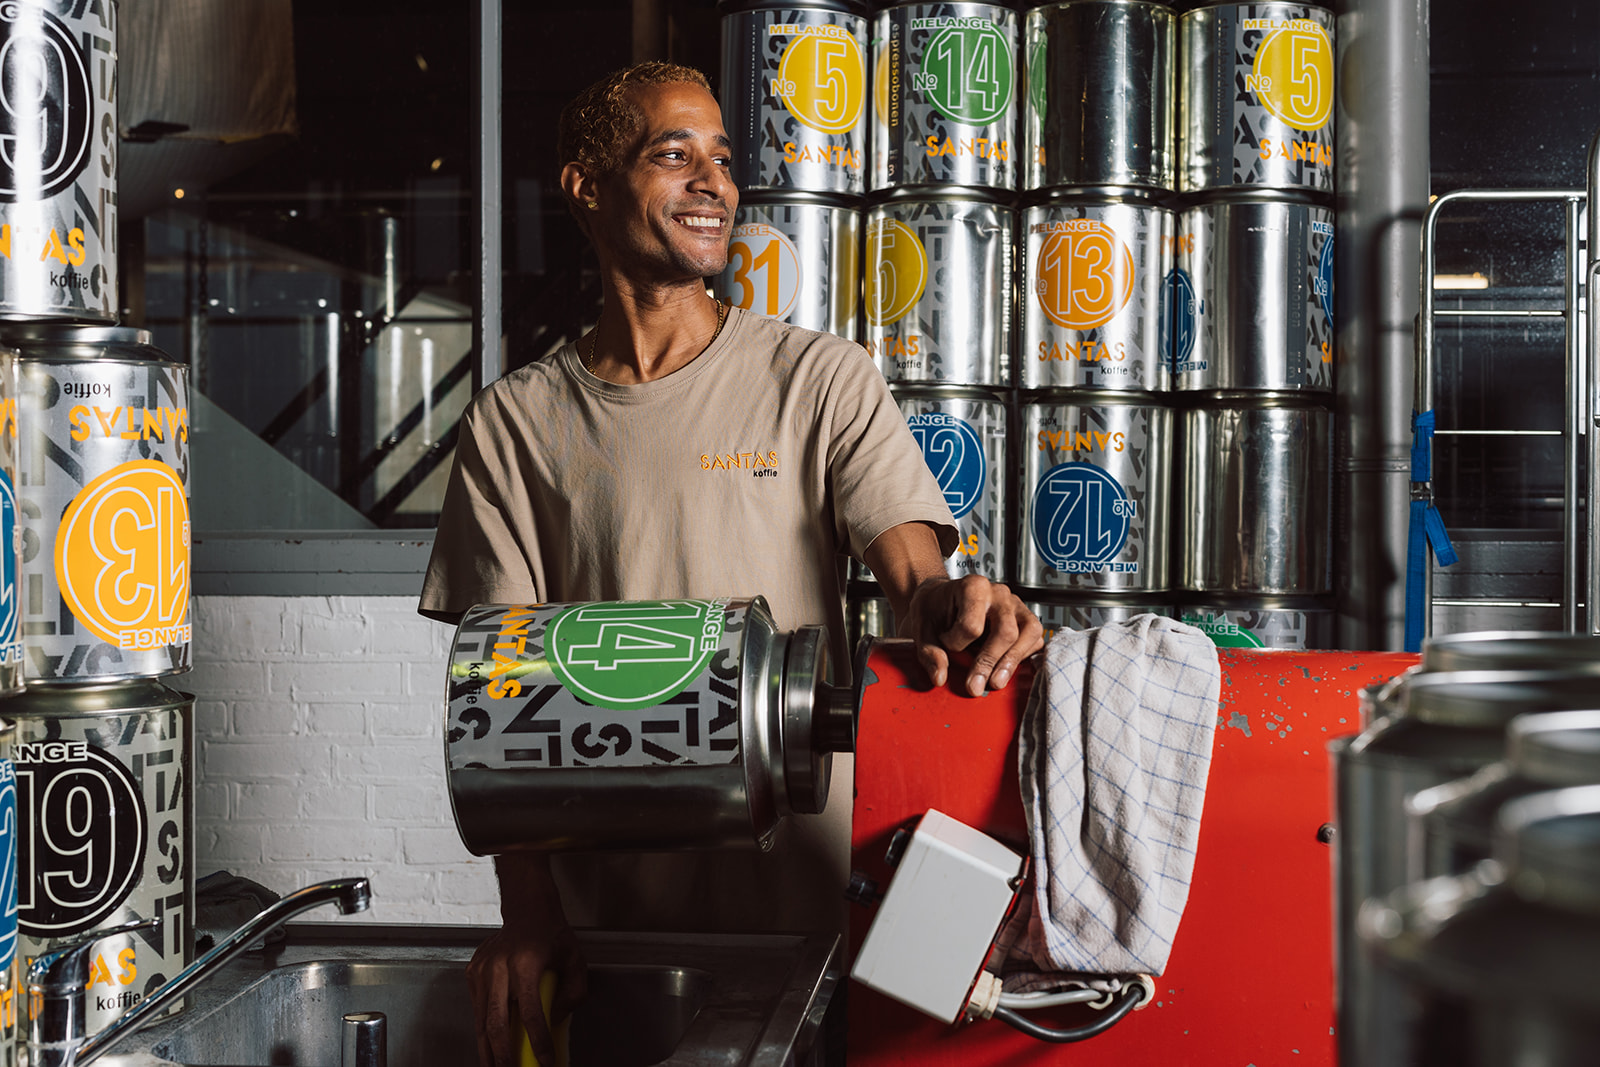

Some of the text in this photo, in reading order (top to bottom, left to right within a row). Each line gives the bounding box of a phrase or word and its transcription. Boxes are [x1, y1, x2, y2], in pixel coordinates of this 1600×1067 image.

[768, 24, 848, 39] MELANGE
[912, 17, 992, 31] MELANGE
[1243, 18, 1320, 32] MELANGE
[814, 39, 848, 124] 5
[891, 23, 900, 127] espressobonen
[938, 31, 999, 112] 14
[1290, 35, 1321, 119] 5
[784, 142, 861, 169] SANTAS
[926, 136, 1008, 161] SANTAS
[1259, 138, 1332, 166] SANTAS
[1030, 220, 1101, 234] MELANGE
[50, 271, 89, 290] koffie
[725, 240, 780, 315] 31
[1045, 234, 1116, 315] 13
[1038, 341, 1125, 362] SANTAS
[1101, 365, 1128, 375] koffie
[64, 382, 111, 398] koffie
[69, 404, 188, 442] SANTAS
[1038, 430, 1125, 452] SANTAS
[700, 451, 778, 470] SANTAS
[753, 468, 778, 478] koffie
[1047, 480, 1110, 557] 12
[89, 486, 185, 625] 13
[956, 559, 980, 569] koffie
[1056, 560, 1138, 573] MELANGE
[567, 601, 701, 671] 14
